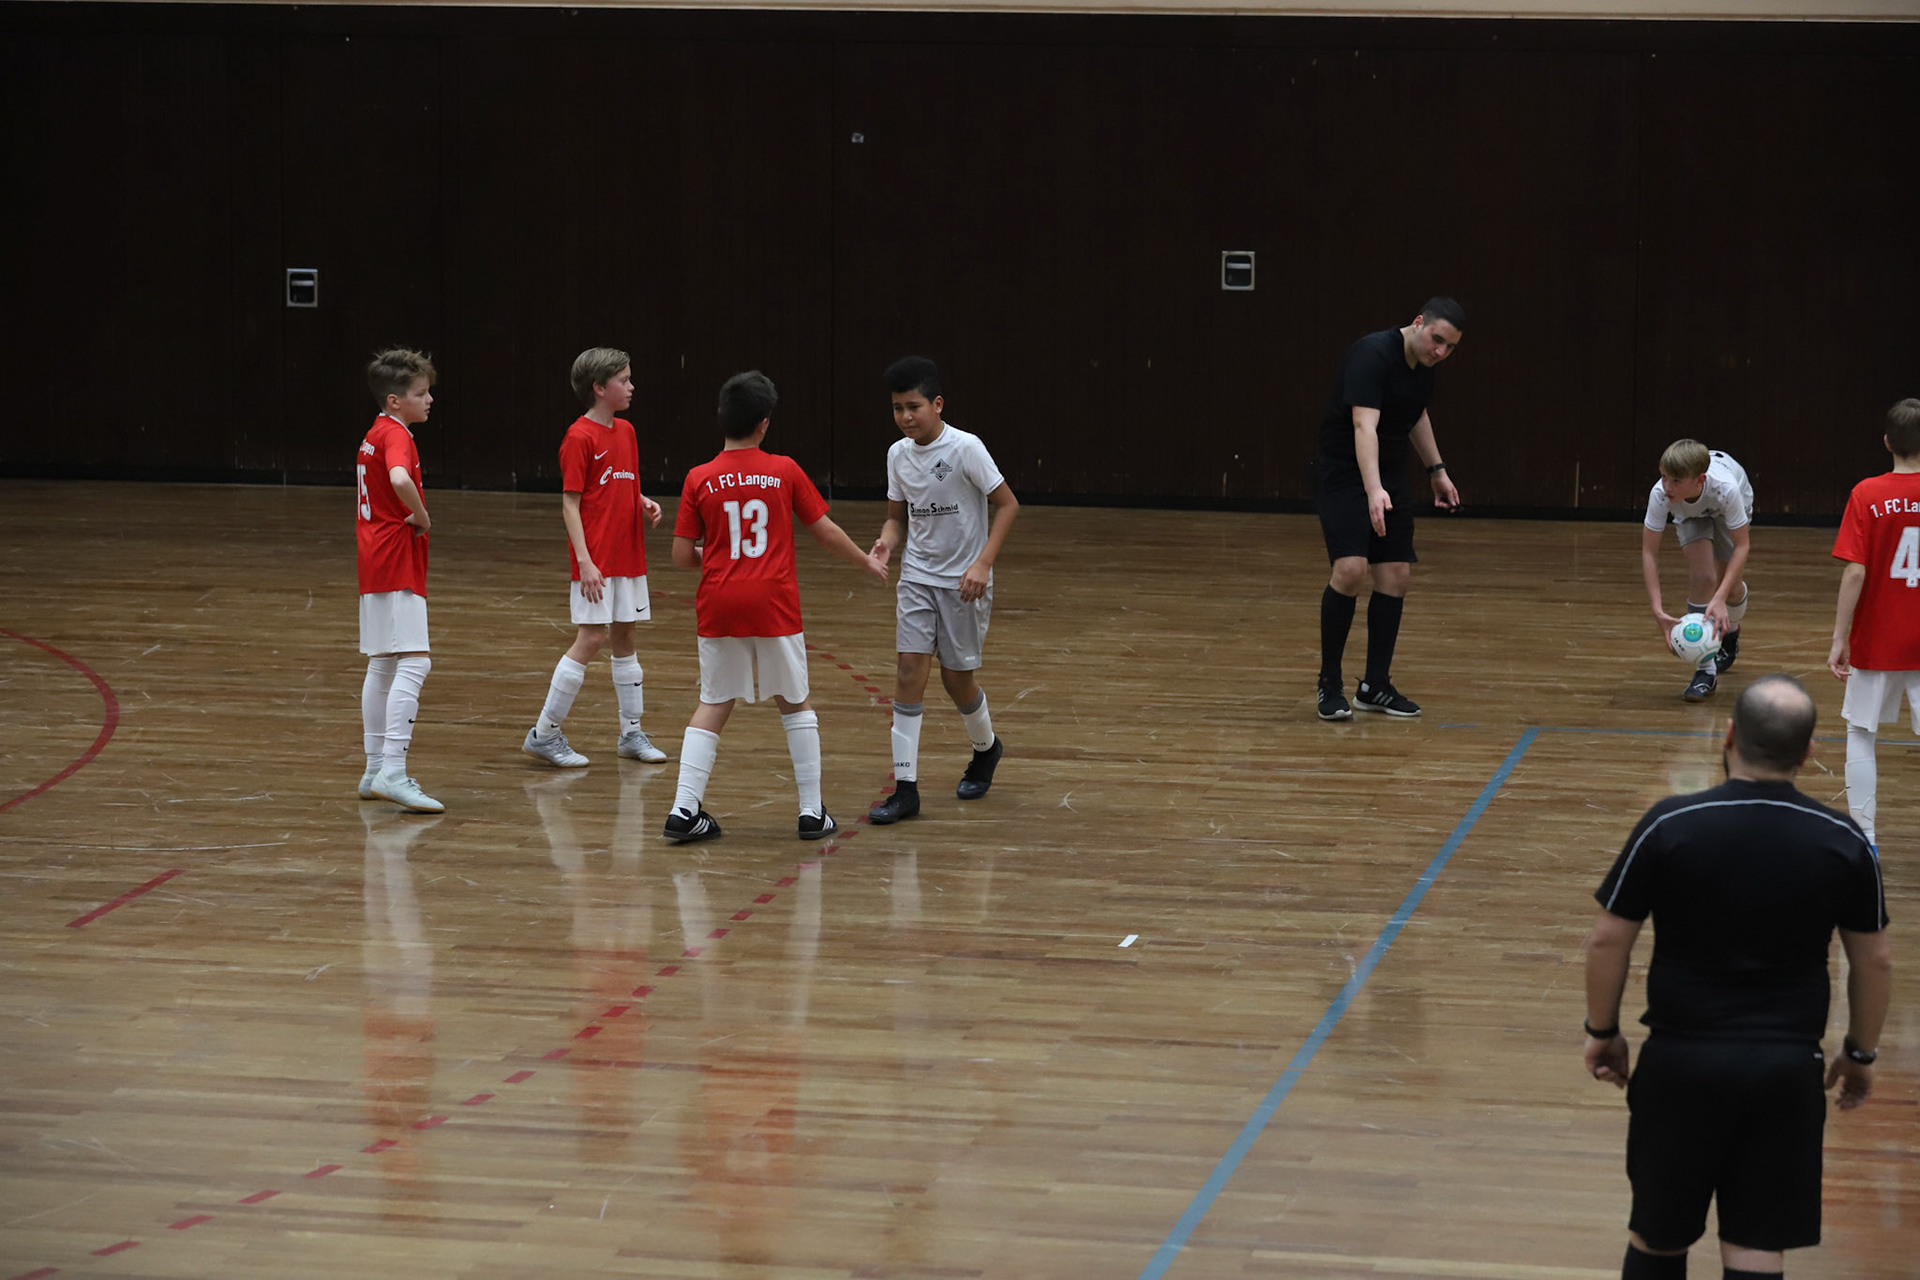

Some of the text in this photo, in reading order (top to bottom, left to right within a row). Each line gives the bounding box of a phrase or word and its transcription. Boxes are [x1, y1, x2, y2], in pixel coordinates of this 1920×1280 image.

[356, 464, 371, 521] 15
[706, 472, 781, 494] 1. FC Langen
[910, 502, 931, 514] Simon
[930, 502, 959, 513] Schmid
[1870, 498, 1920, 518] 1. FC La
[723, 498, 769, 560] 13
[1890, 526, 1920, 588] 4
